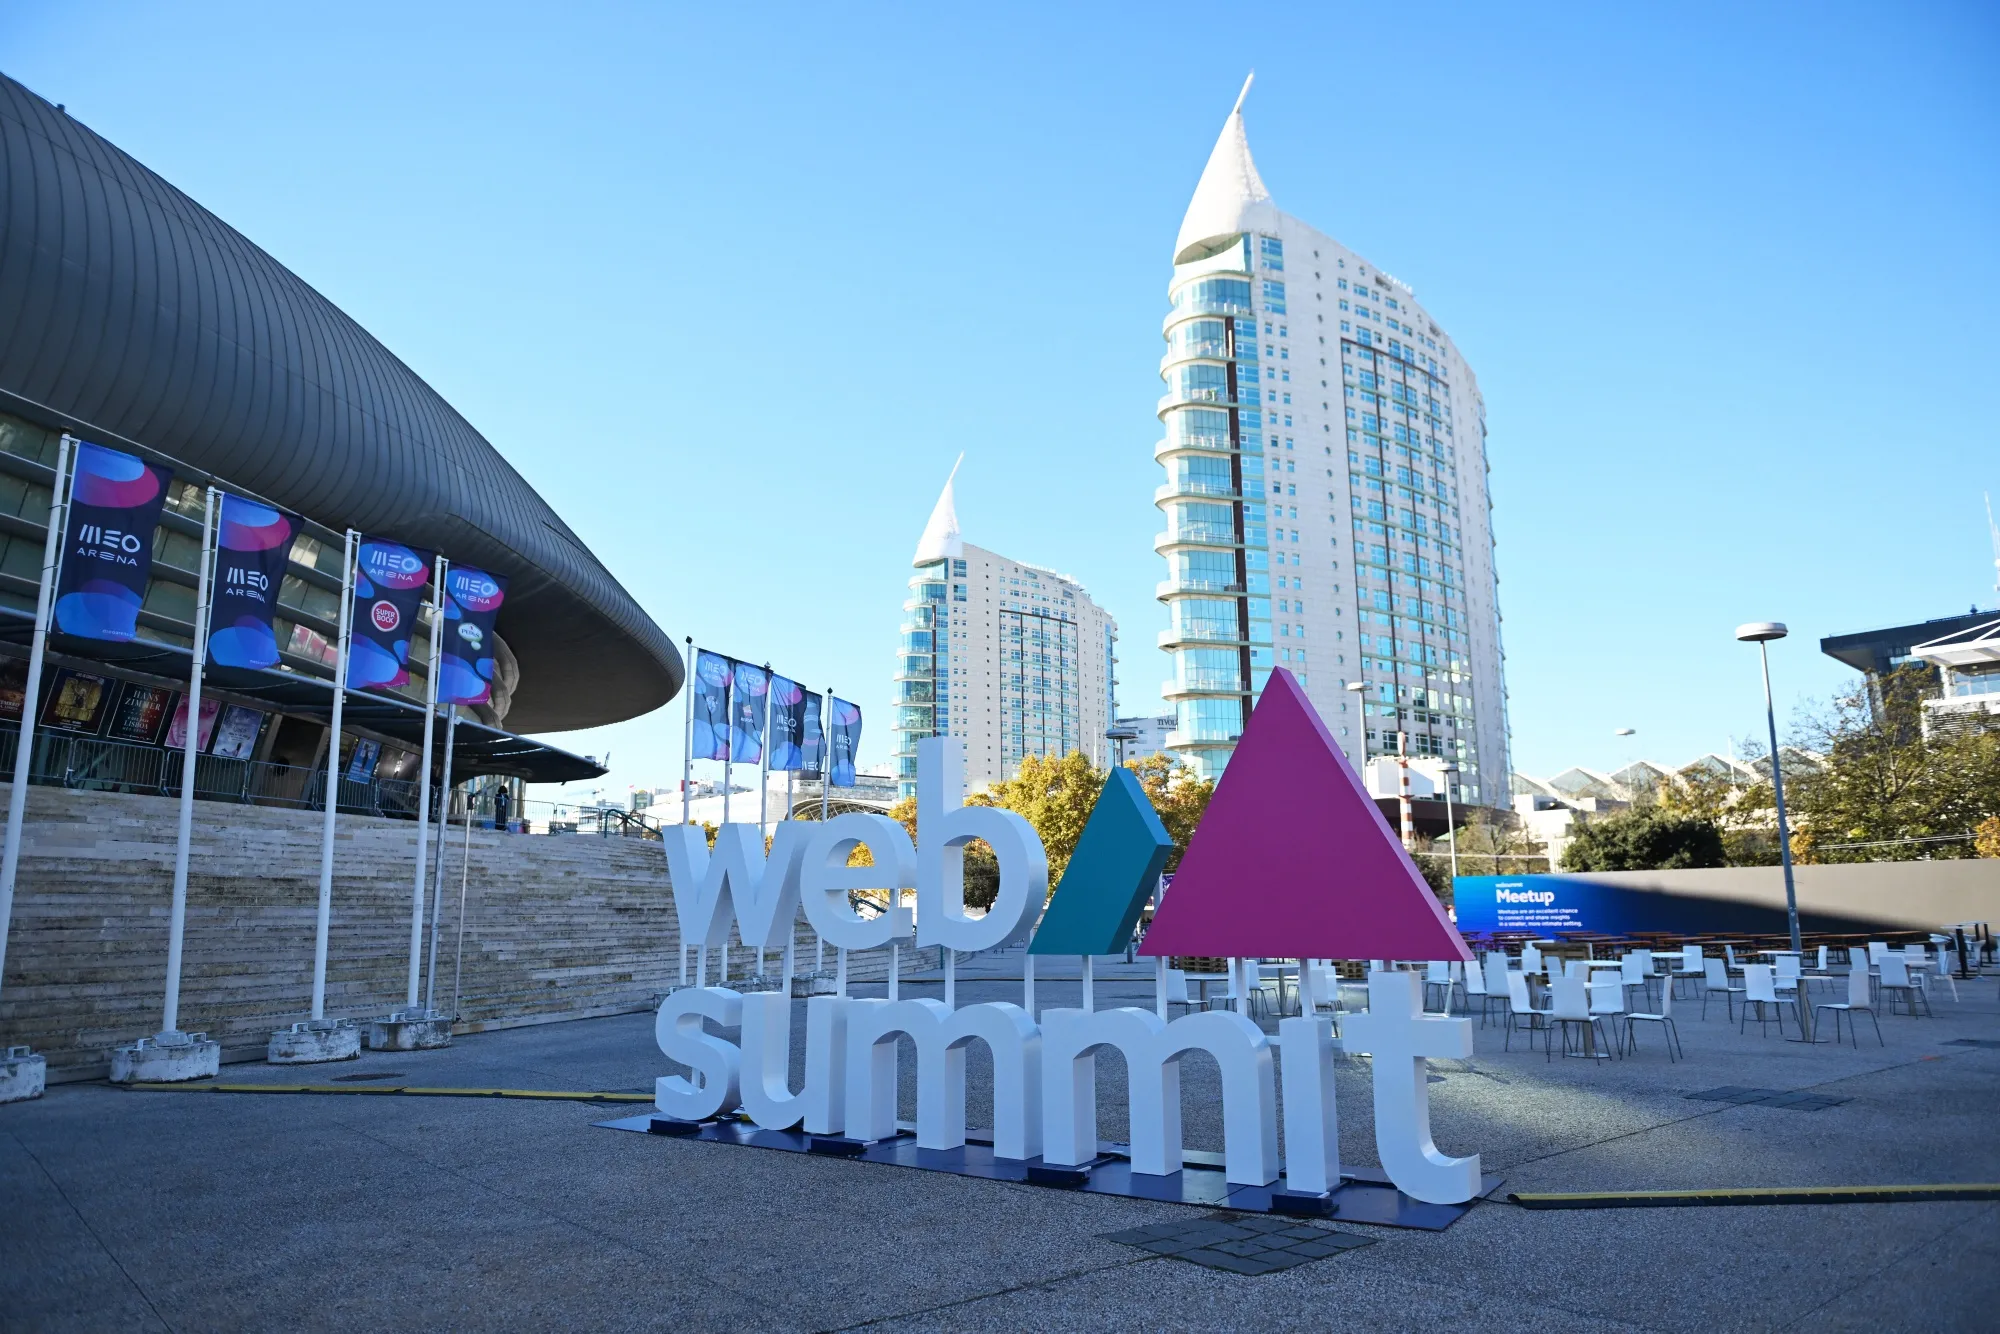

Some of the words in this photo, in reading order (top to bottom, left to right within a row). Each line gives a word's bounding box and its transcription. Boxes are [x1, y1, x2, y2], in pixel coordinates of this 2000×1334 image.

[79, 524, 140, 553] MEO
[77, 547, 137, 566] ARENA
[371, 550, 416, 571] MEO
[227, 567, 268, 591] MEO
[370, 568, 413, 582] ARENA
[456, 576, 494, 595] MEO
[226, 587, 265, 604] ARENA
[456, 592, 490, 605] ARENA
[376, 608, 395, 618] SUPER
[376, 615, 394, 624] BOCK
[776, 714, 797, 728] MEO
[661, 736, 1049, 952] web
[1496, 889, 1555, 907] Meetup
[654, 971, 1482, 1205] summit
